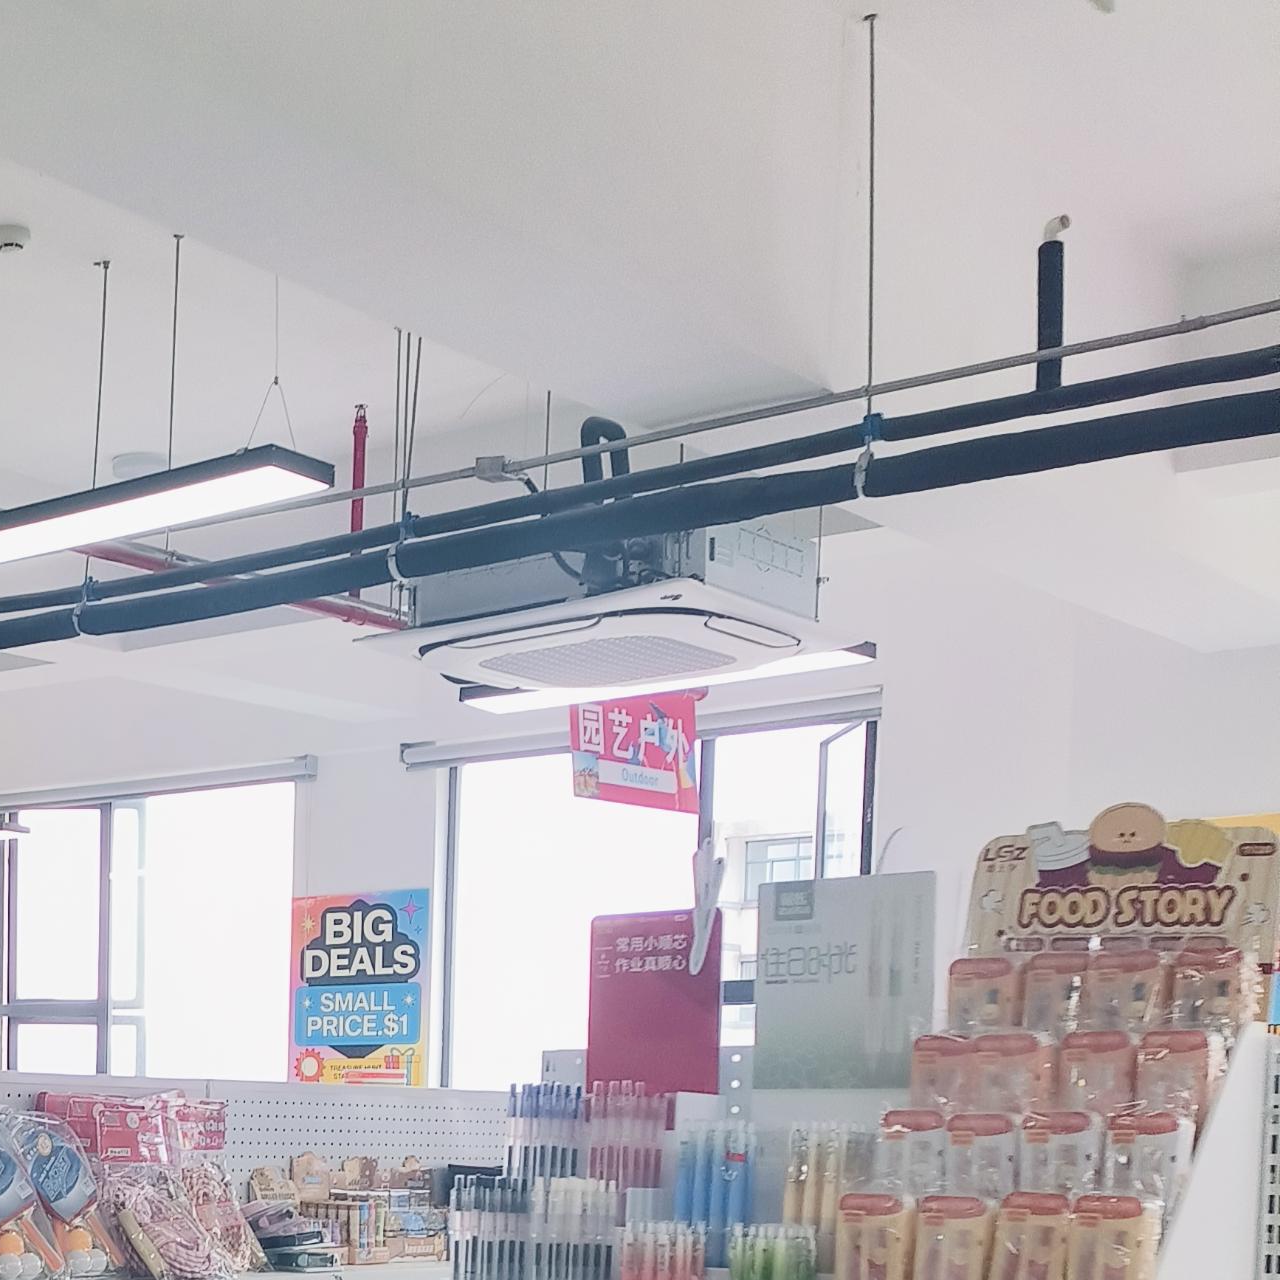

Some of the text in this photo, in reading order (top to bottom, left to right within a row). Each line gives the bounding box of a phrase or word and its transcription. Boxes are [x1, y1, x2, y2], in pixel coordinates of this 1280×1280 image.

[578, 704, 690, 768] 园艺户外
[621, 768, 660, 786] Outdoor
[1018, 885, 1237, 928] FOOD STORY
[325, 909, 393, 945] BIG
[305, 944, 416, 978] DEALS
[320, 991, 396, 1012] SMALL
[307, 1012, 408, 1037] PRICE.$1
